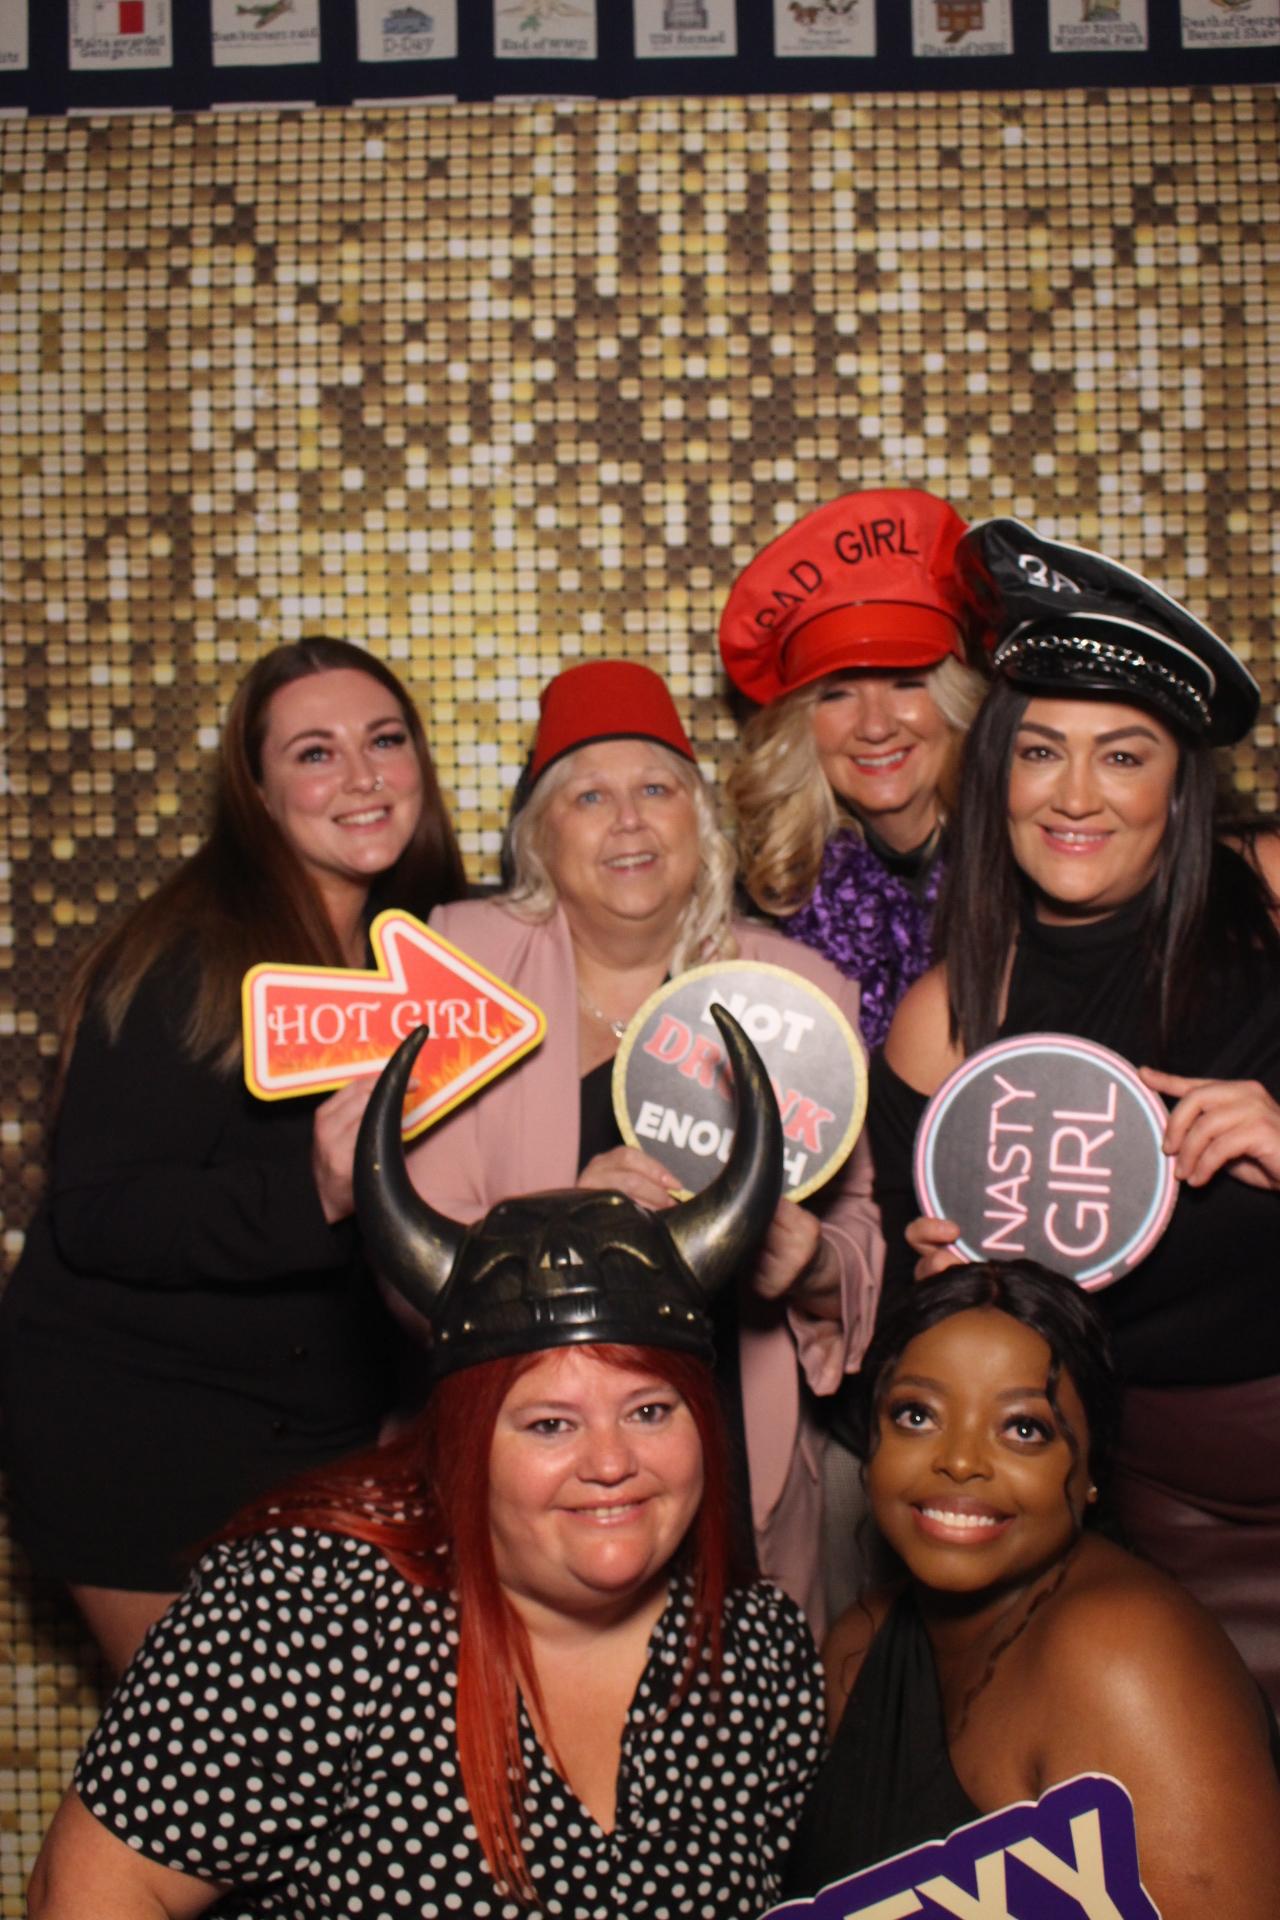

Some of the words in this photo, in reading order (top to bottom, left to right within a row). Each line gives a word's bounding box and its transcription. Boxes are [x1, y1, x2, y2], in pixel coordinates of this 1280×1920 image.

[383, 37, 434, 54] D-Day
[501, 38, 528, 50] End
[755, 560, 823, 630] BAD
[834, 518, 920, 565] GIRL
[268, 1002, 381, 1046] HOT
[391, 998, 502, 1045] GIRL
[702, 989, 816, 1053] NOT
[981, 1073, 1037, 1252] NASTY
[1044, 1082, 1118, 1257] GIRL
